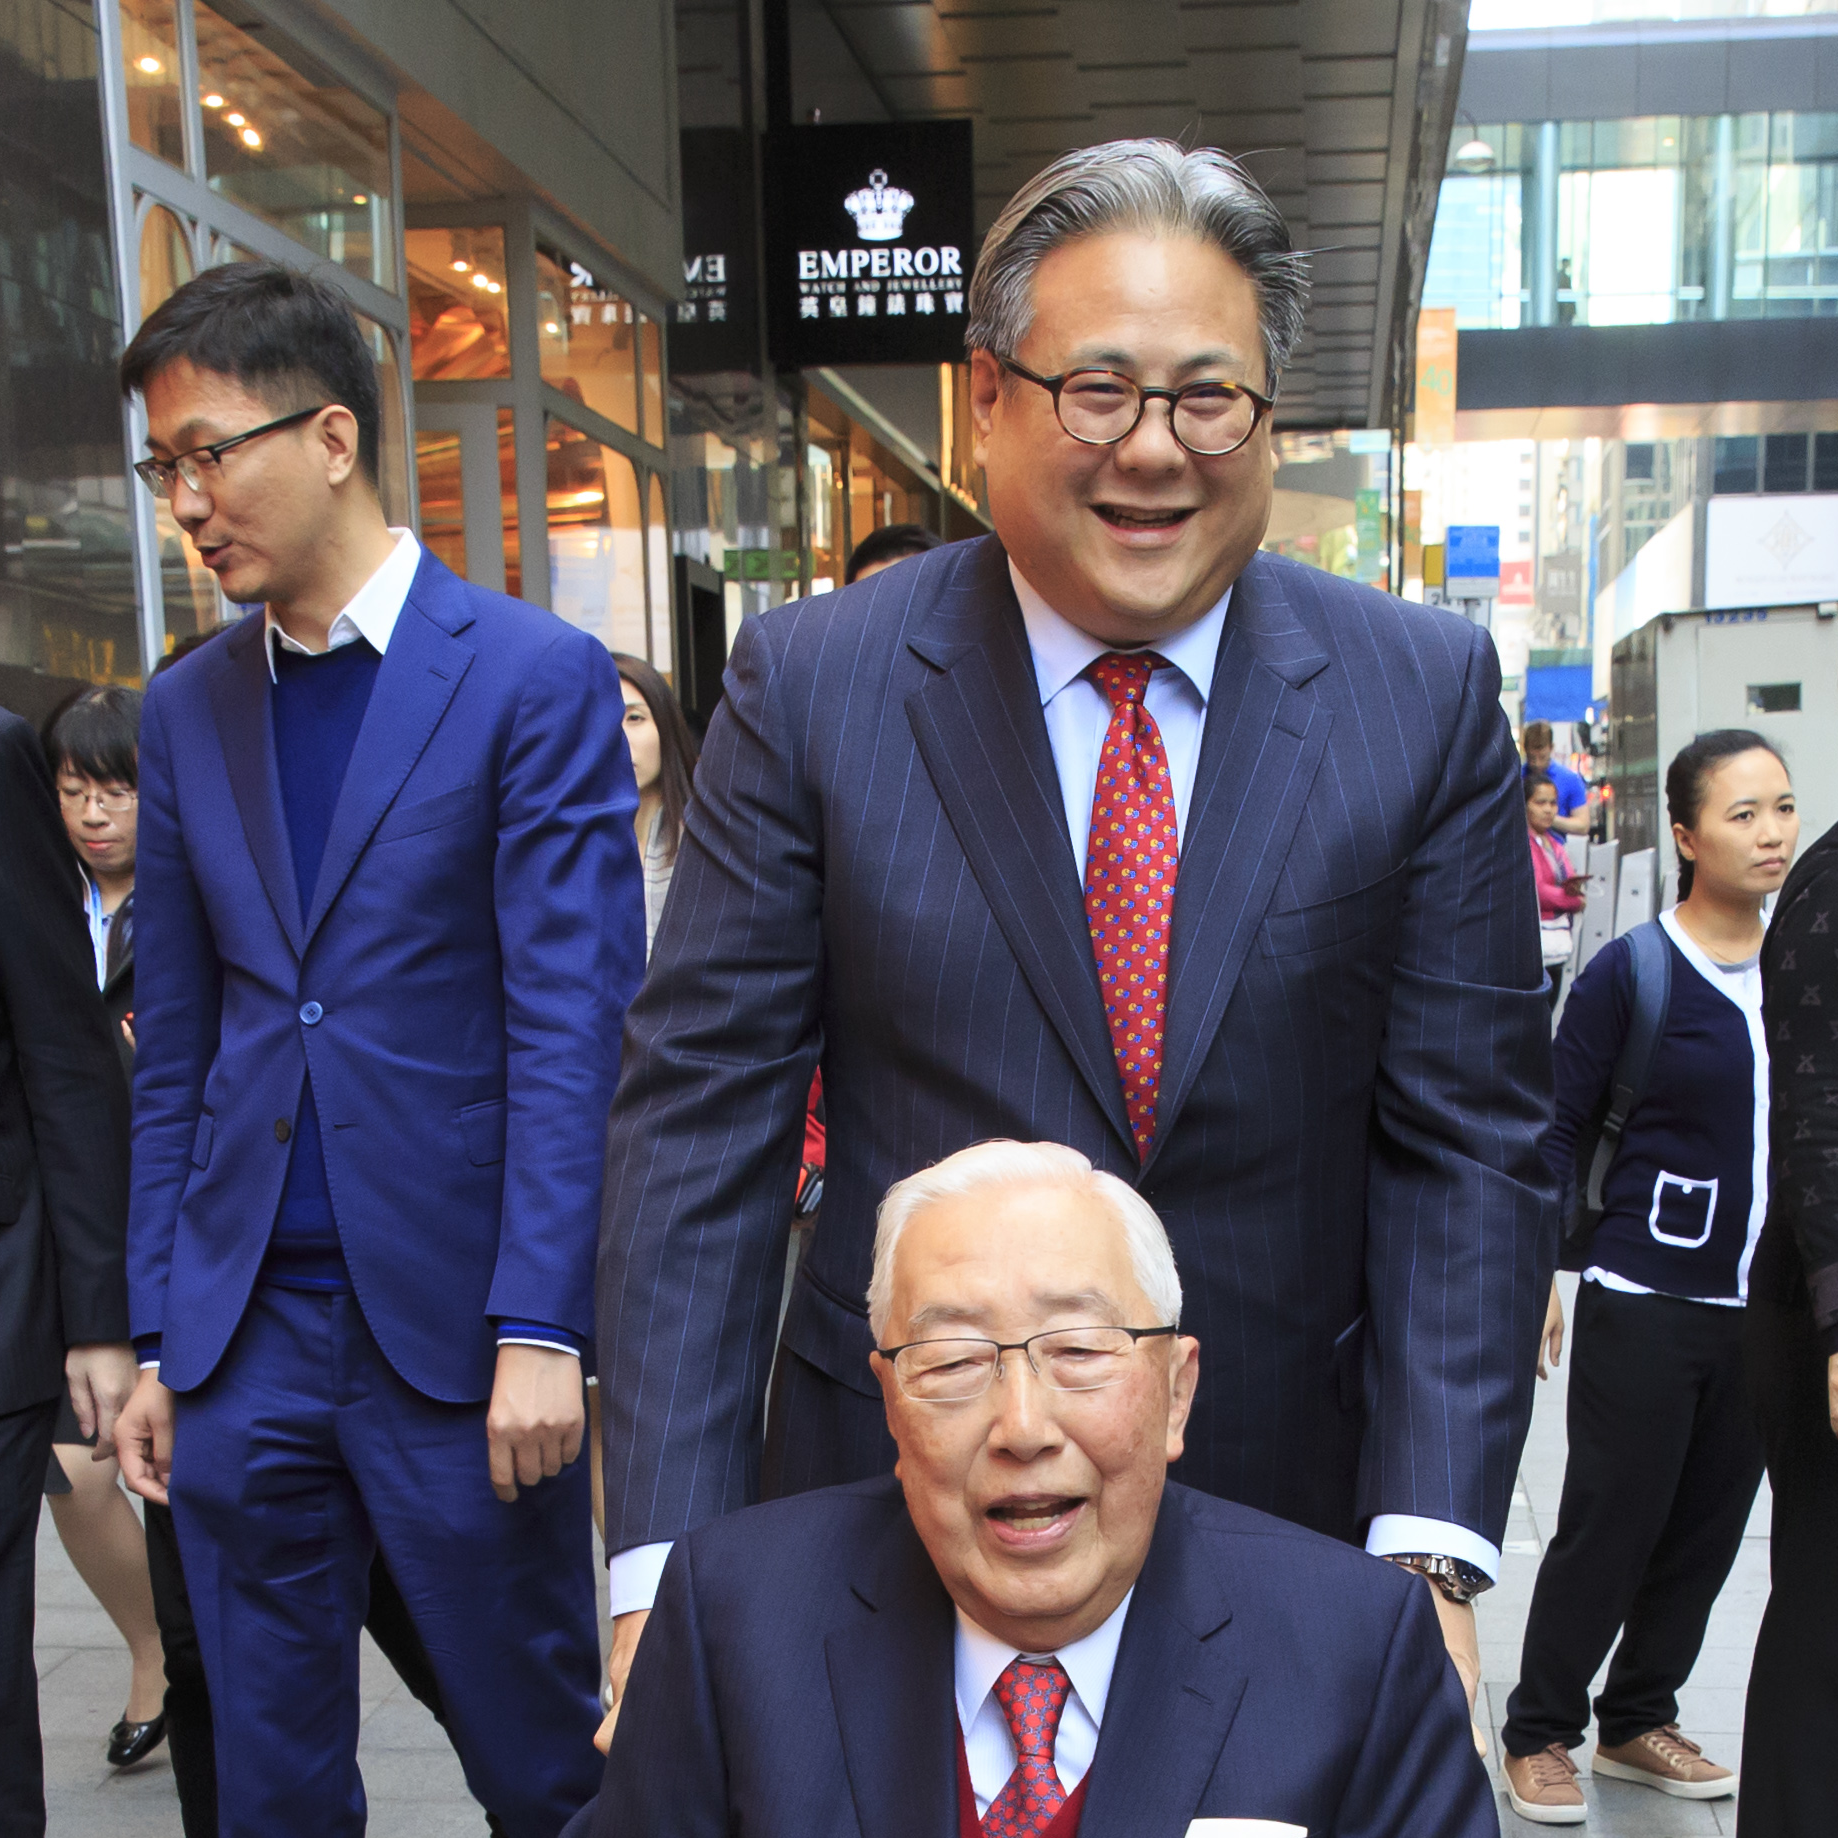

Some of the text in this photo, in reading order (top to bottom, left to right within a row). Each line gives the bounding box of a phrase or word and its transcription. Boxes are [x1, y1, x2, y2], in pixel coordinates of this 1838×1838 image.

[798, 246, 962, 280] EMPEROR
[799, 277, 963, 294] WATCH AND JEWELLERY
